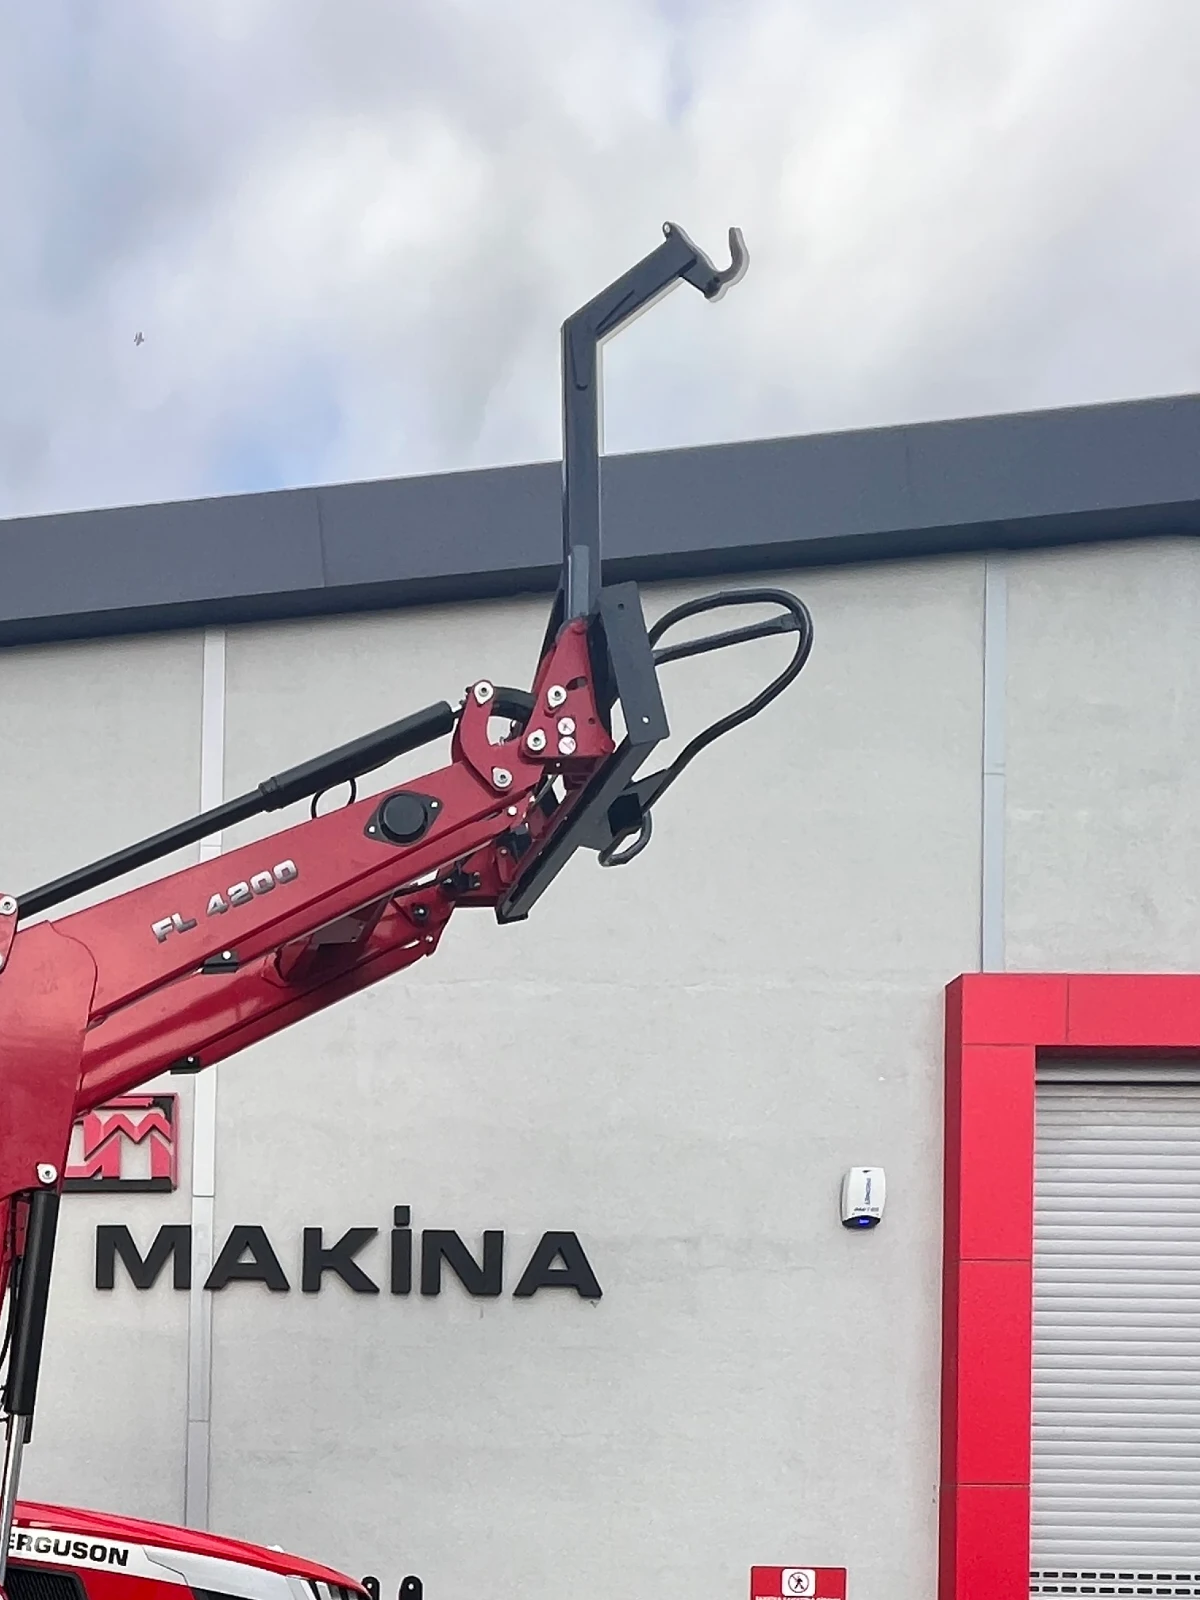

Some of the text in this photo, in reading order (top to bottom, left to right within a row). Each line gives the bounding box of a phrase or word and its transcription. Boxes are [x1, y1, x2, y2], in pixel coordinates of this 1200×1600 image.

[151, 857, 299, 944] FL 4200
[95, 1204, 603, 1299] MAKİNA
